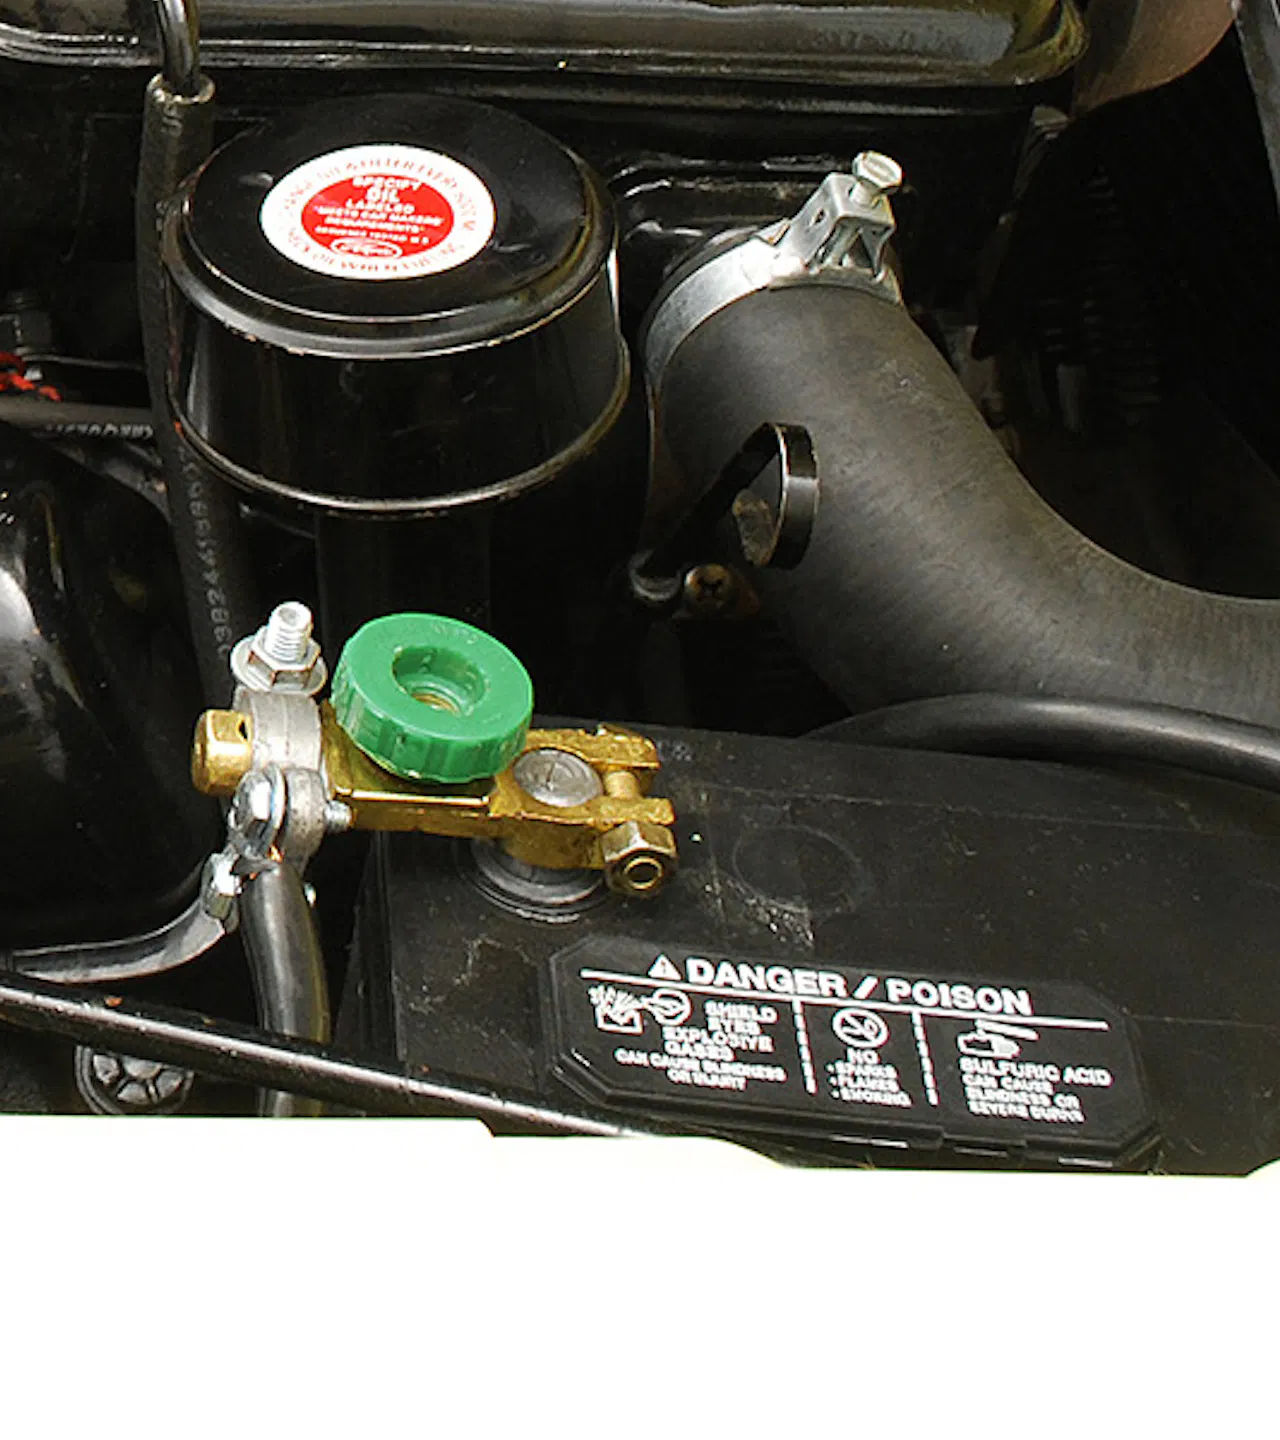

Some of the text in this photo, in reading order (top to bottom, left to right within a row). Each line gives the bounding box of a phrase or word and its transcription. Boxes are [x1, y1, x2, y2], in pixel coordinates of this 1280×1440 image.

[366, 186, 400, 202] OIL
[685, 957, 849, 997] DANGER
[885, 978, 1034, 1016] POISON
[846, 1047, 880, 1064] NO
[959, 1057, 1114, 1087] SULFURIC ACID
[962, 1073, 998, 1090] CAN
[1053, 1093, 1081, 1110] OR
